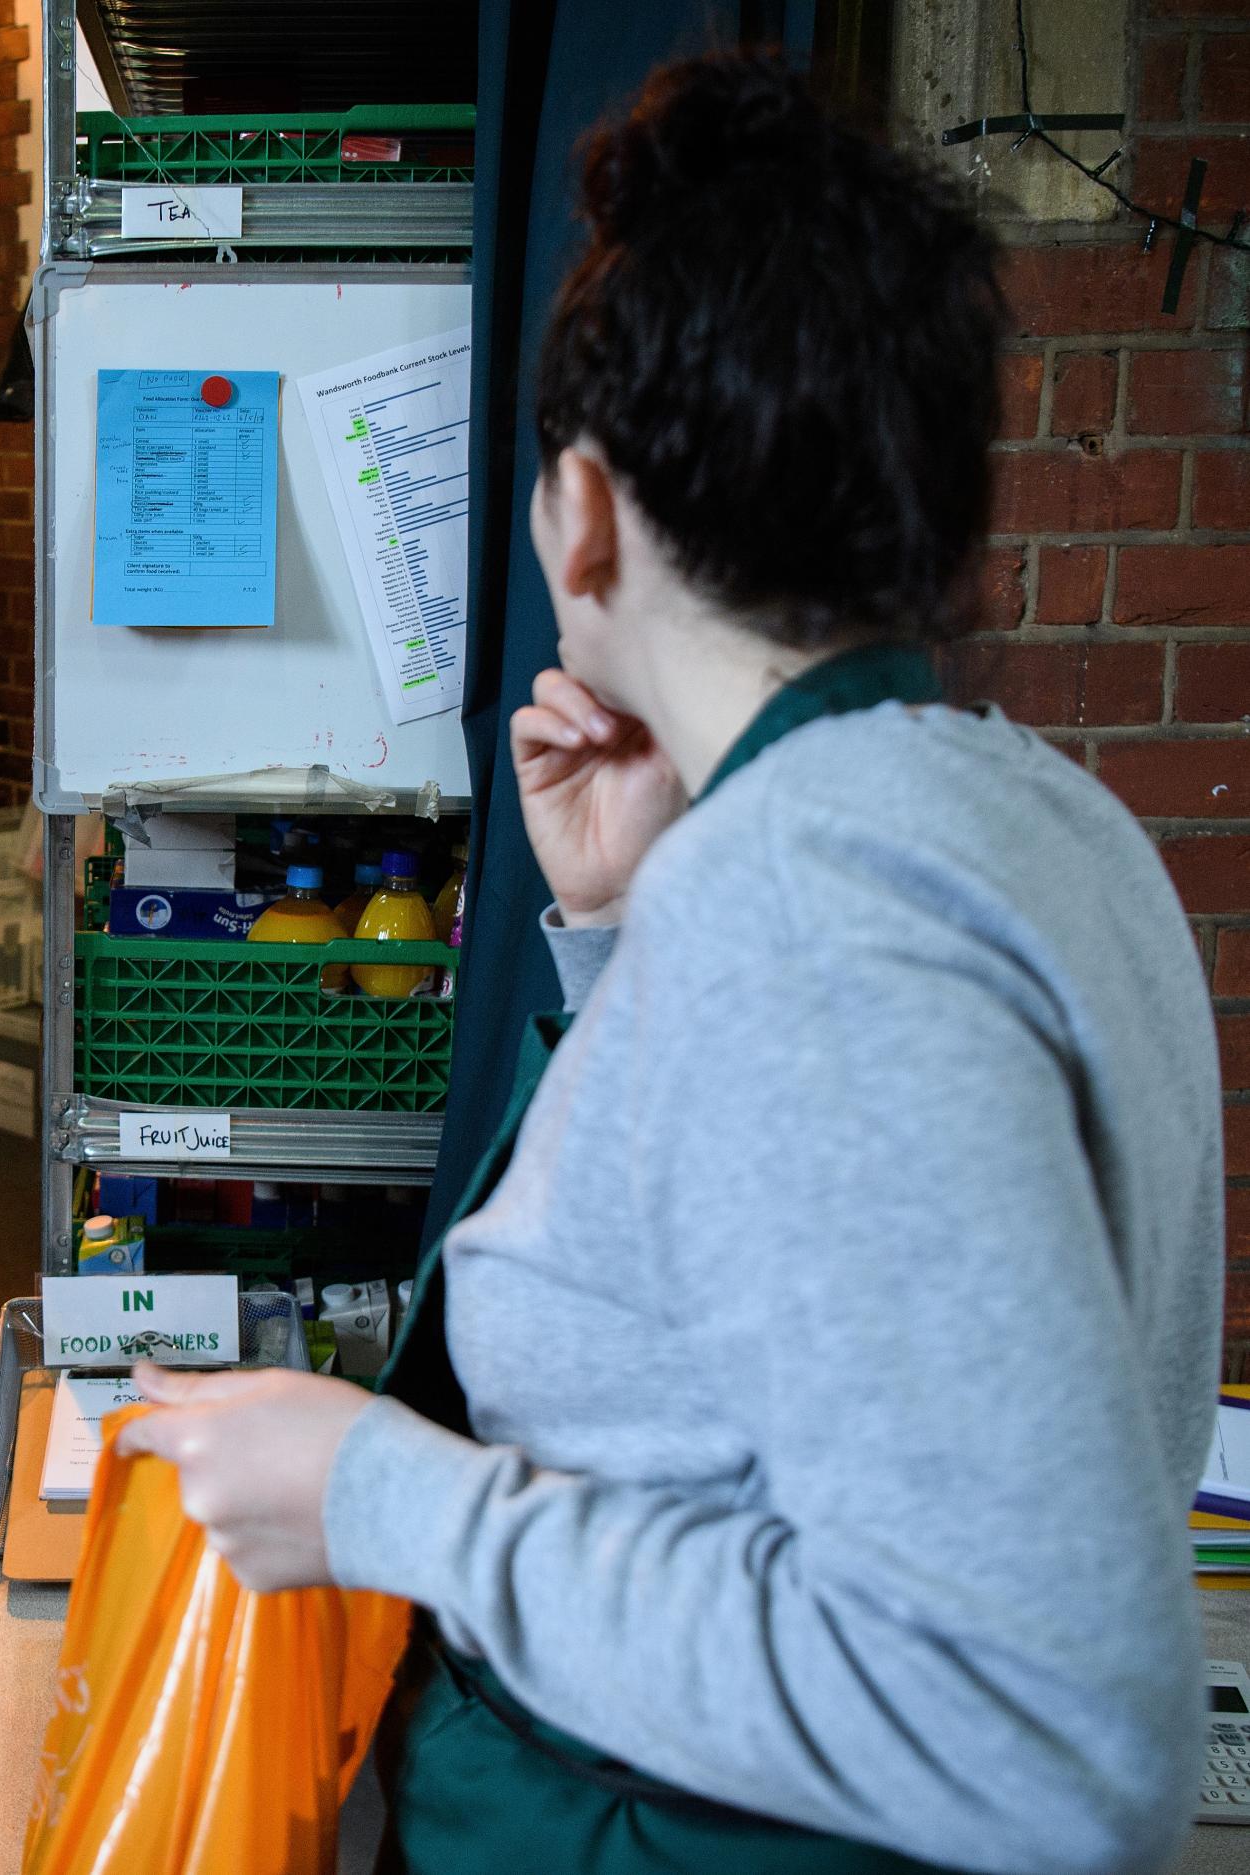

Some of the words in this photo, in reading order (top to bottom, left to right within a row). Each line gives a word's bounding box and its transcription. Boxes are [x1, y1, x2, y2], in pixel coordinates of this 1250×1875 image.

[148, 200, 191, 224] TEA
[316, 378, 362, 398] Wandsworth
[364, 366, 399, 383] Foodbank
[400, 358, 426, 372] Current
[428, 351, 447, 363] Stock
[448, 344, 470, 356] Levels
[140, 1125, 189, 1147] FRUIT
[122, 1290, 154, 1311] IN
[60, 1335, 111, 1354] FOOD
[1210, 1746, 1220, 1754] 8
[1238, 1747, 1246, 1755] 9
[1220, 1760, 1229, 1769] 5
[1229, 1776, 1238, 1784] 2
[1210, 1790, 1220, 1799] 0
